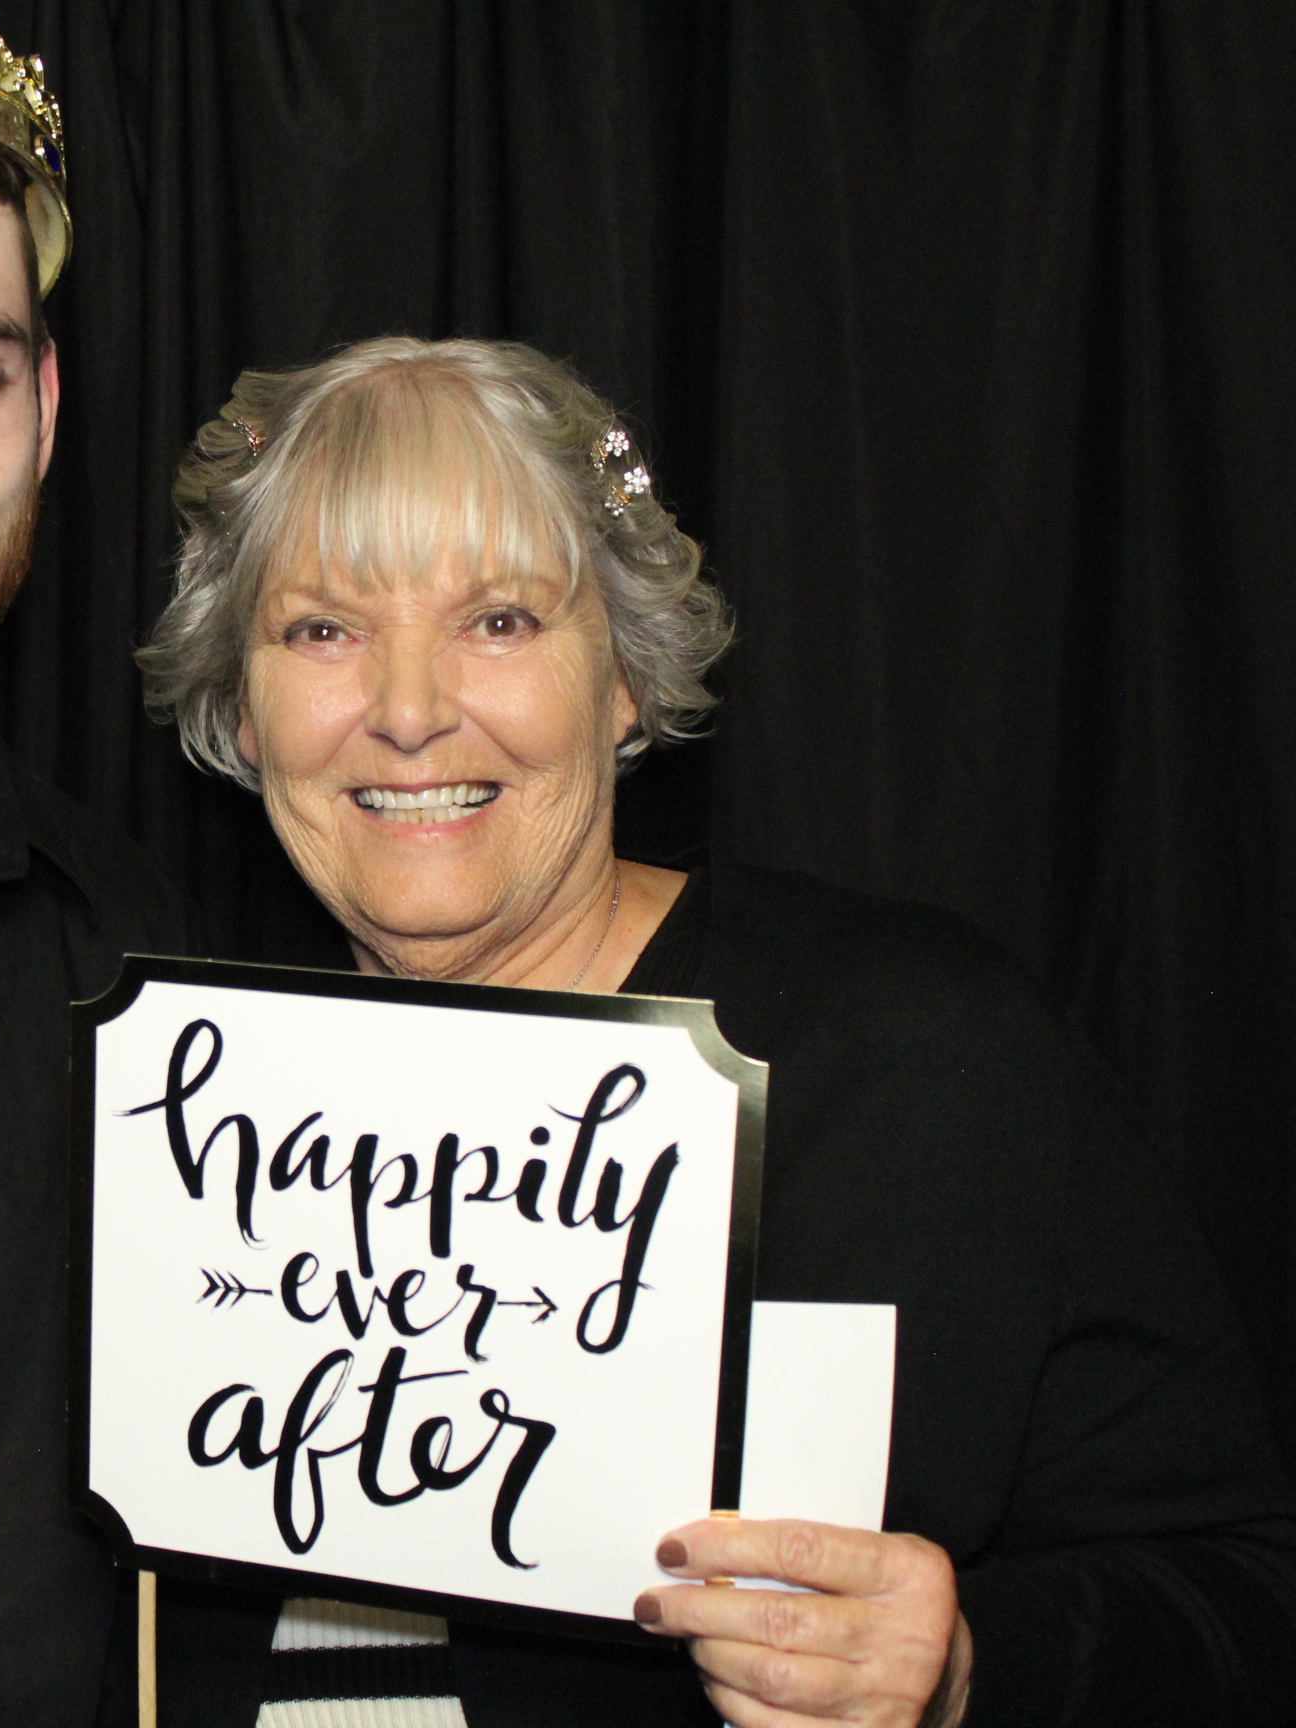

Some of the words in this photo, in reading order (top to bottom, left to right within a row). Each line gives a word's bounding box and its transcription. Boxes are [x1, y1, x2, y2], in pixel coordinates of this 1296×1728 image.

[114, 1018, 680, 1354] happily
[280, 1252, 497, 1361] ever
[188, 1347, 557, 1570] after
